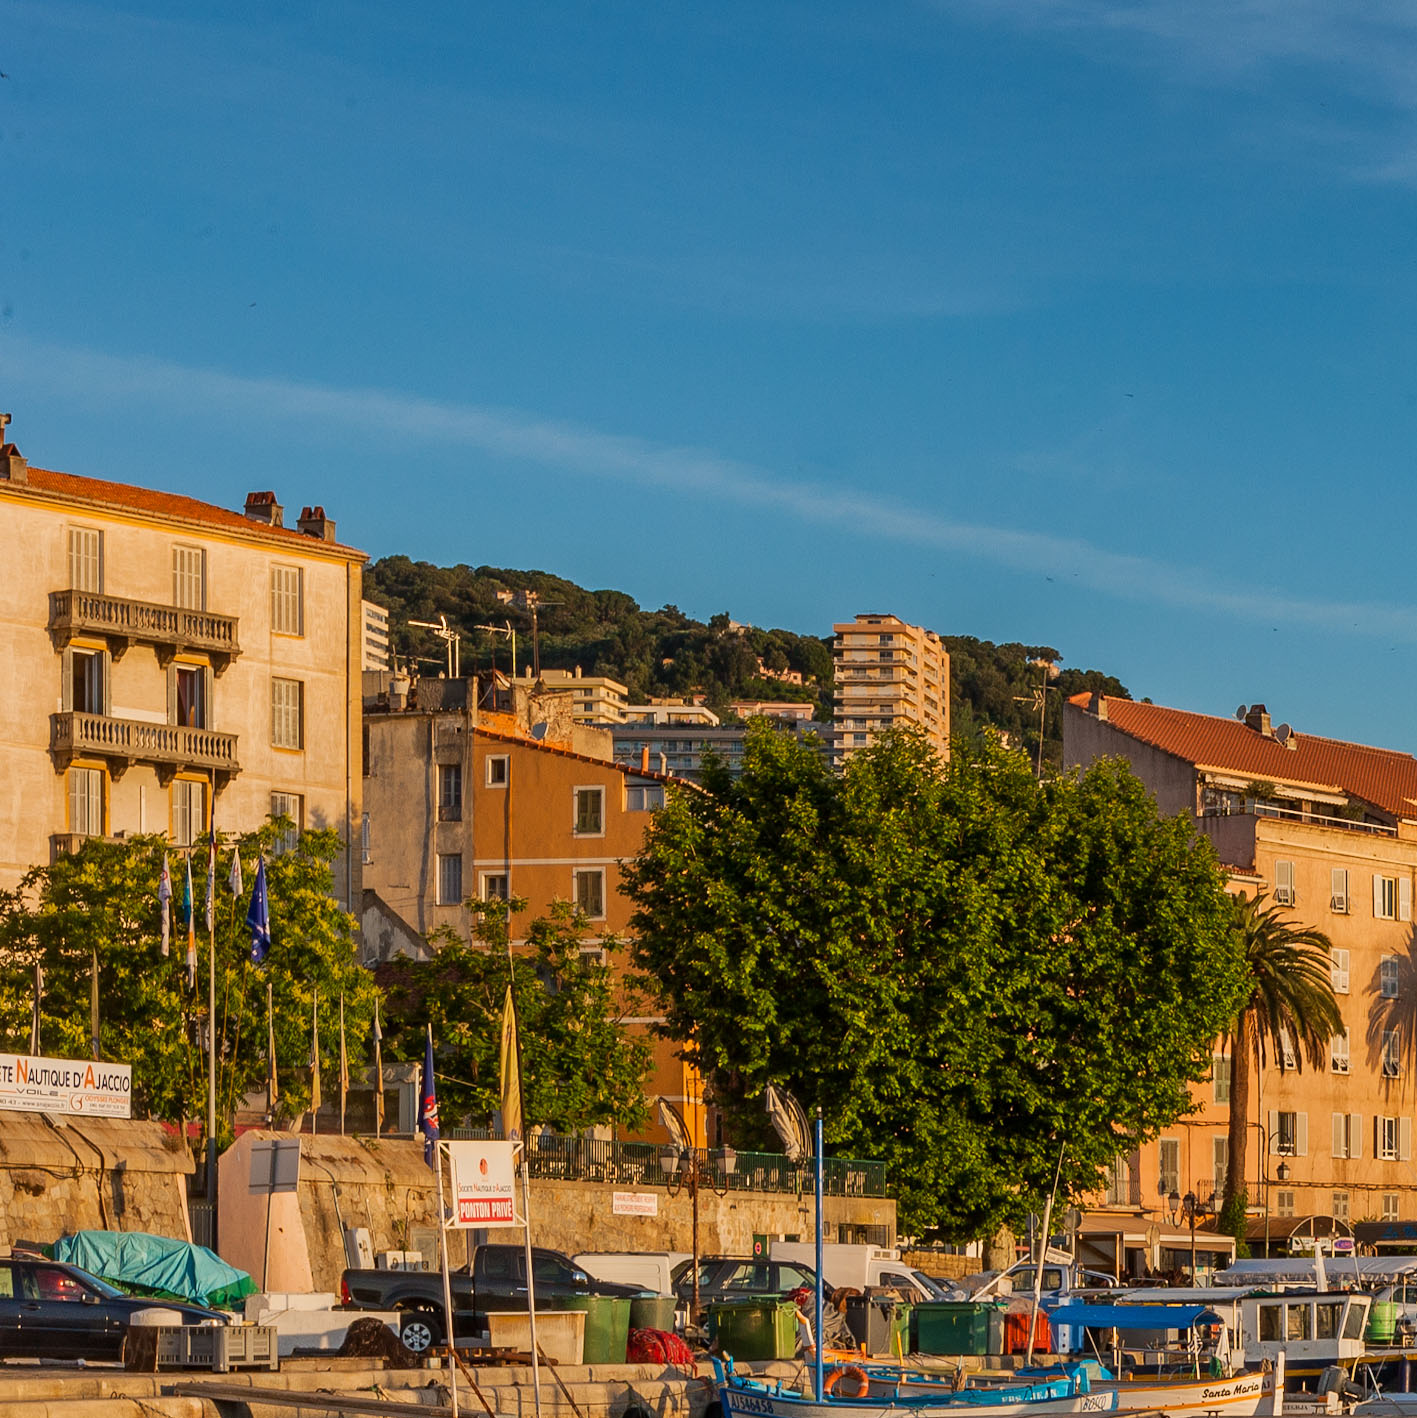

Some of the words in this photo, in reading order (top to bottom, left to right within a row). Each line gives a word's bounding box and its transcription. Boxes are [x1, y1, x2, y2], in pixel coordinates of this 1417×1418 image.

[16, 1058, 70, 1088] NAUTIQUE
[73, 1064, 130, 1092] D'AJACCIO
[460, 1202, 491, 1219] PONTON
[491, 1199, 512, 1218] PRIVÉ
[1201, 1388, 1232, 1398] Santa
[1233, 1382, 1260, 1395] Maria
